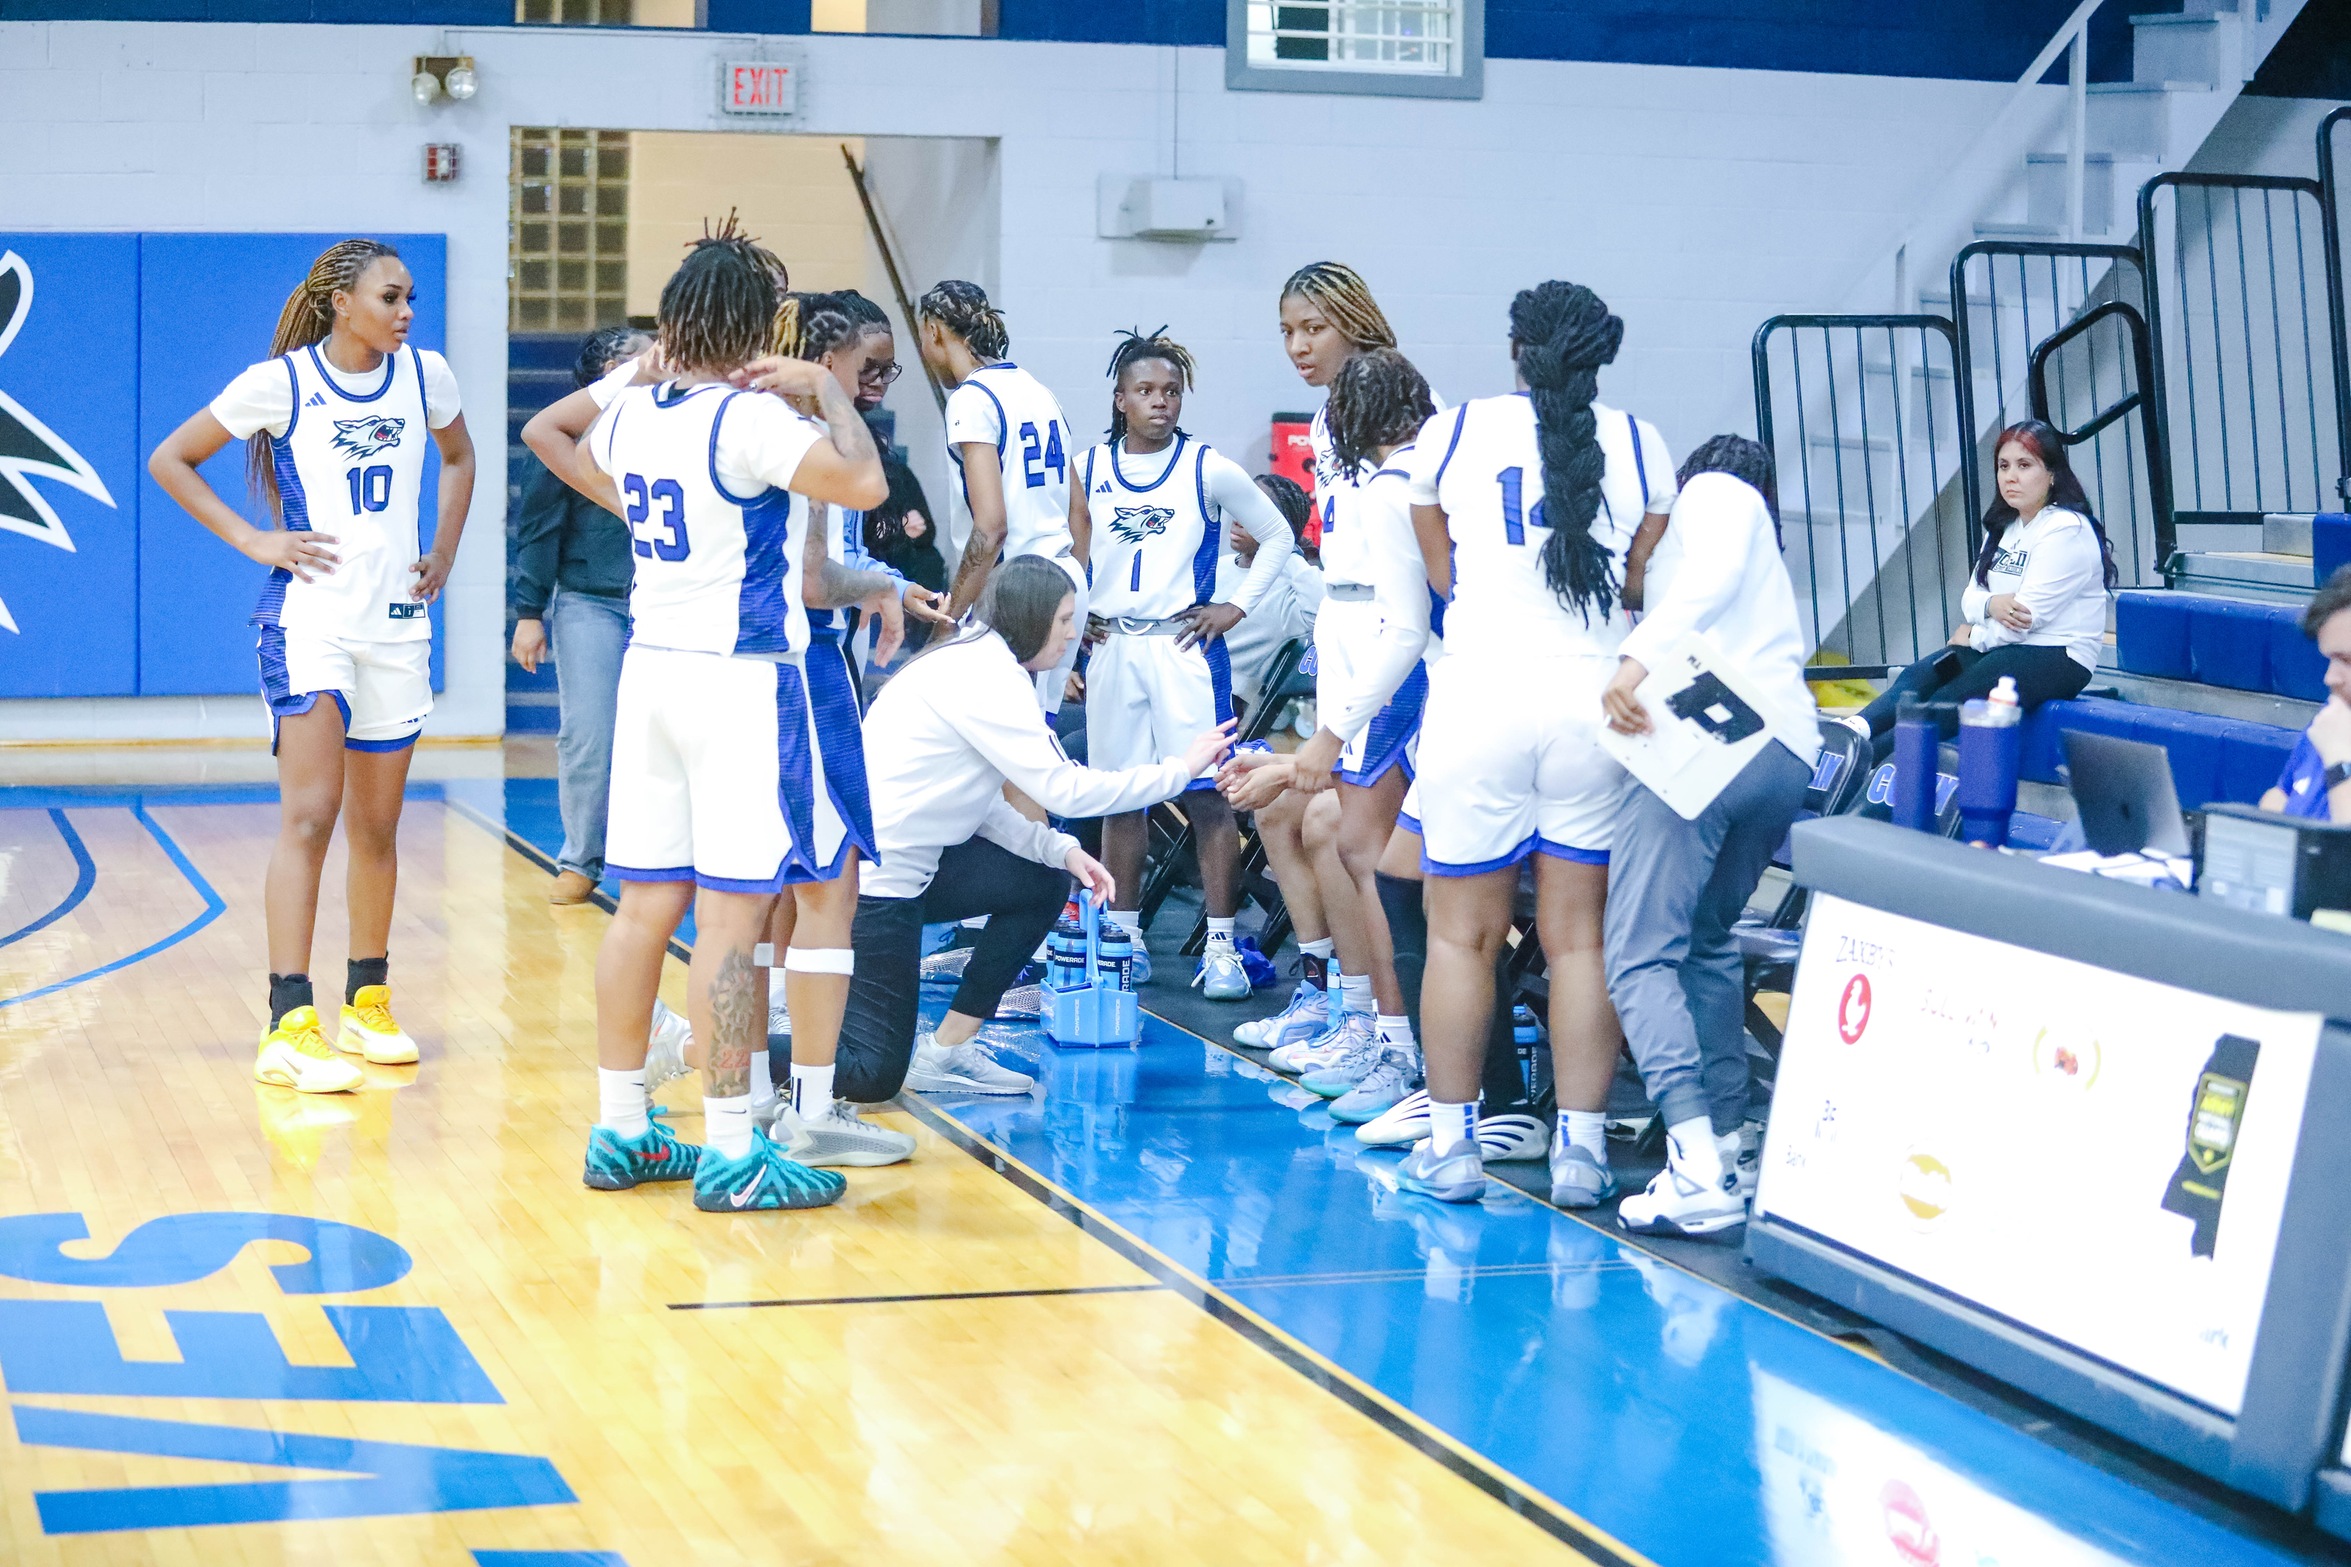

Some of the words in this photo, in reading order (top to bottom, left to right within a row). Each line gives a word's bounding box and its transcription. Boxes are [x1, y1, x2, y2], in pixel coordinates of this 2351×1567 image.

[734, 67, 788, 107] EXIT
[1019, 419, 1065, 489] 24
[346, 464, 394, 516] 10
[623, 472, 691, 562] 23
[1130, 548, 1142, 592] 1
[1055, 955, 1085, 963] POWERADE
